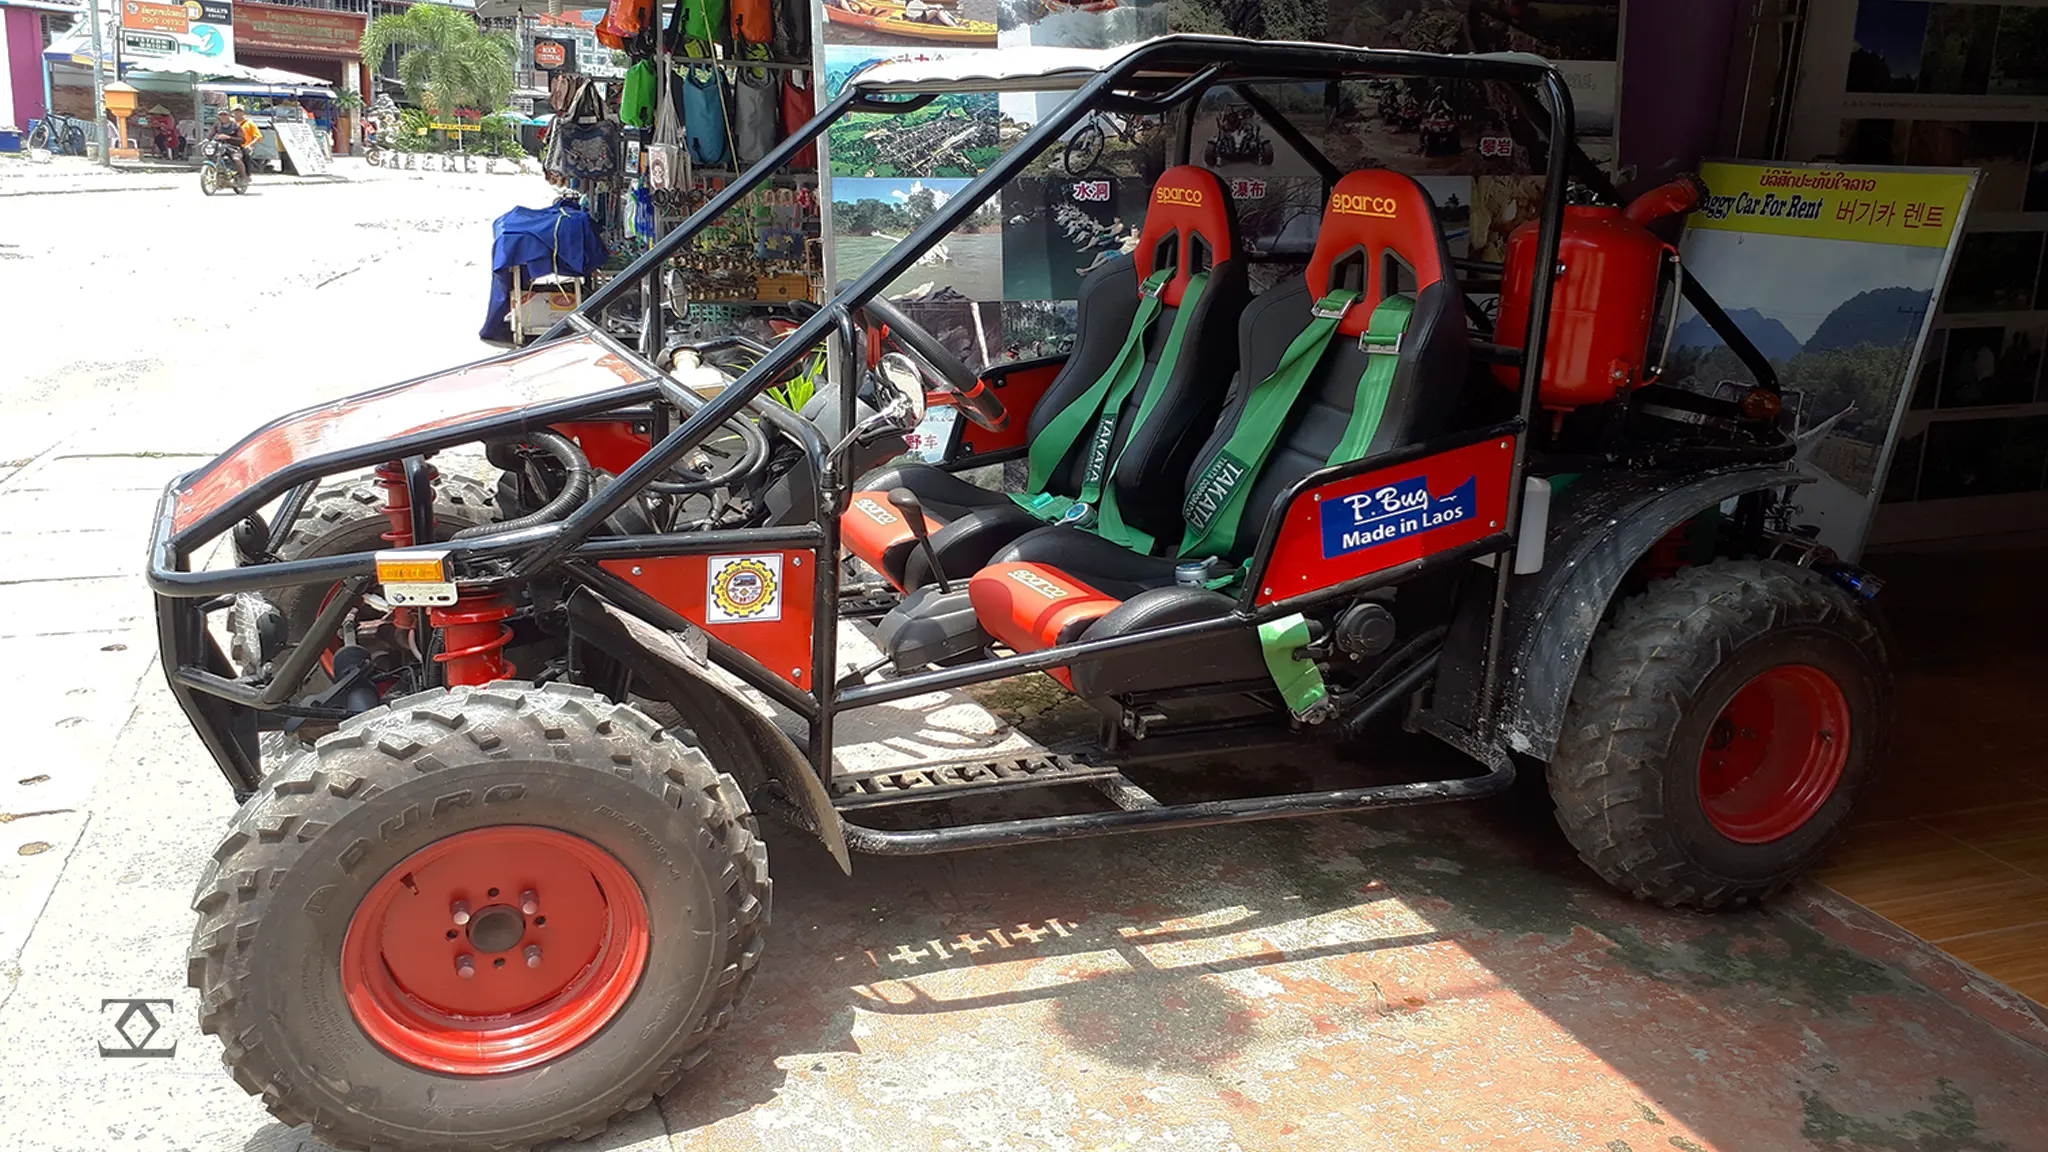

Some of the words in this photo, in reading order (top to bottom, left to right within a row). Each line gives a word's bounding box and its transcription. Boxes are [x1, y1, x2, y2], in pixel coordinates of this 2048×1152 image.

[142, 16, 160, 25] POST
[162, 18, 186, 27] OFFICE
[1074, 182, 1109, 200] 水洞
[1156, 186, 1203, 206] sparco
[1331, 193, 1397, 215] sparco
[1736, 190, 1761, 216] Car
[1760, 192, 1788, 217] For
[1787, 195, 1825, 220] Rent
[1835, 199, 1896, 228] 버기카
[1902, 202, 1946, 229] 렌트
[1090, 417, 1115, 482] TAKATA
[1190, 462, 1245, 529] TAKATA
[857, 498, 899, 525] sparco
[1342, 524, 1396, 549] Made
[1400, 517, 1418, 535] in
[1422, 505, 1464, 528] Laos
[1013, 569, 1069, 599] sparco
